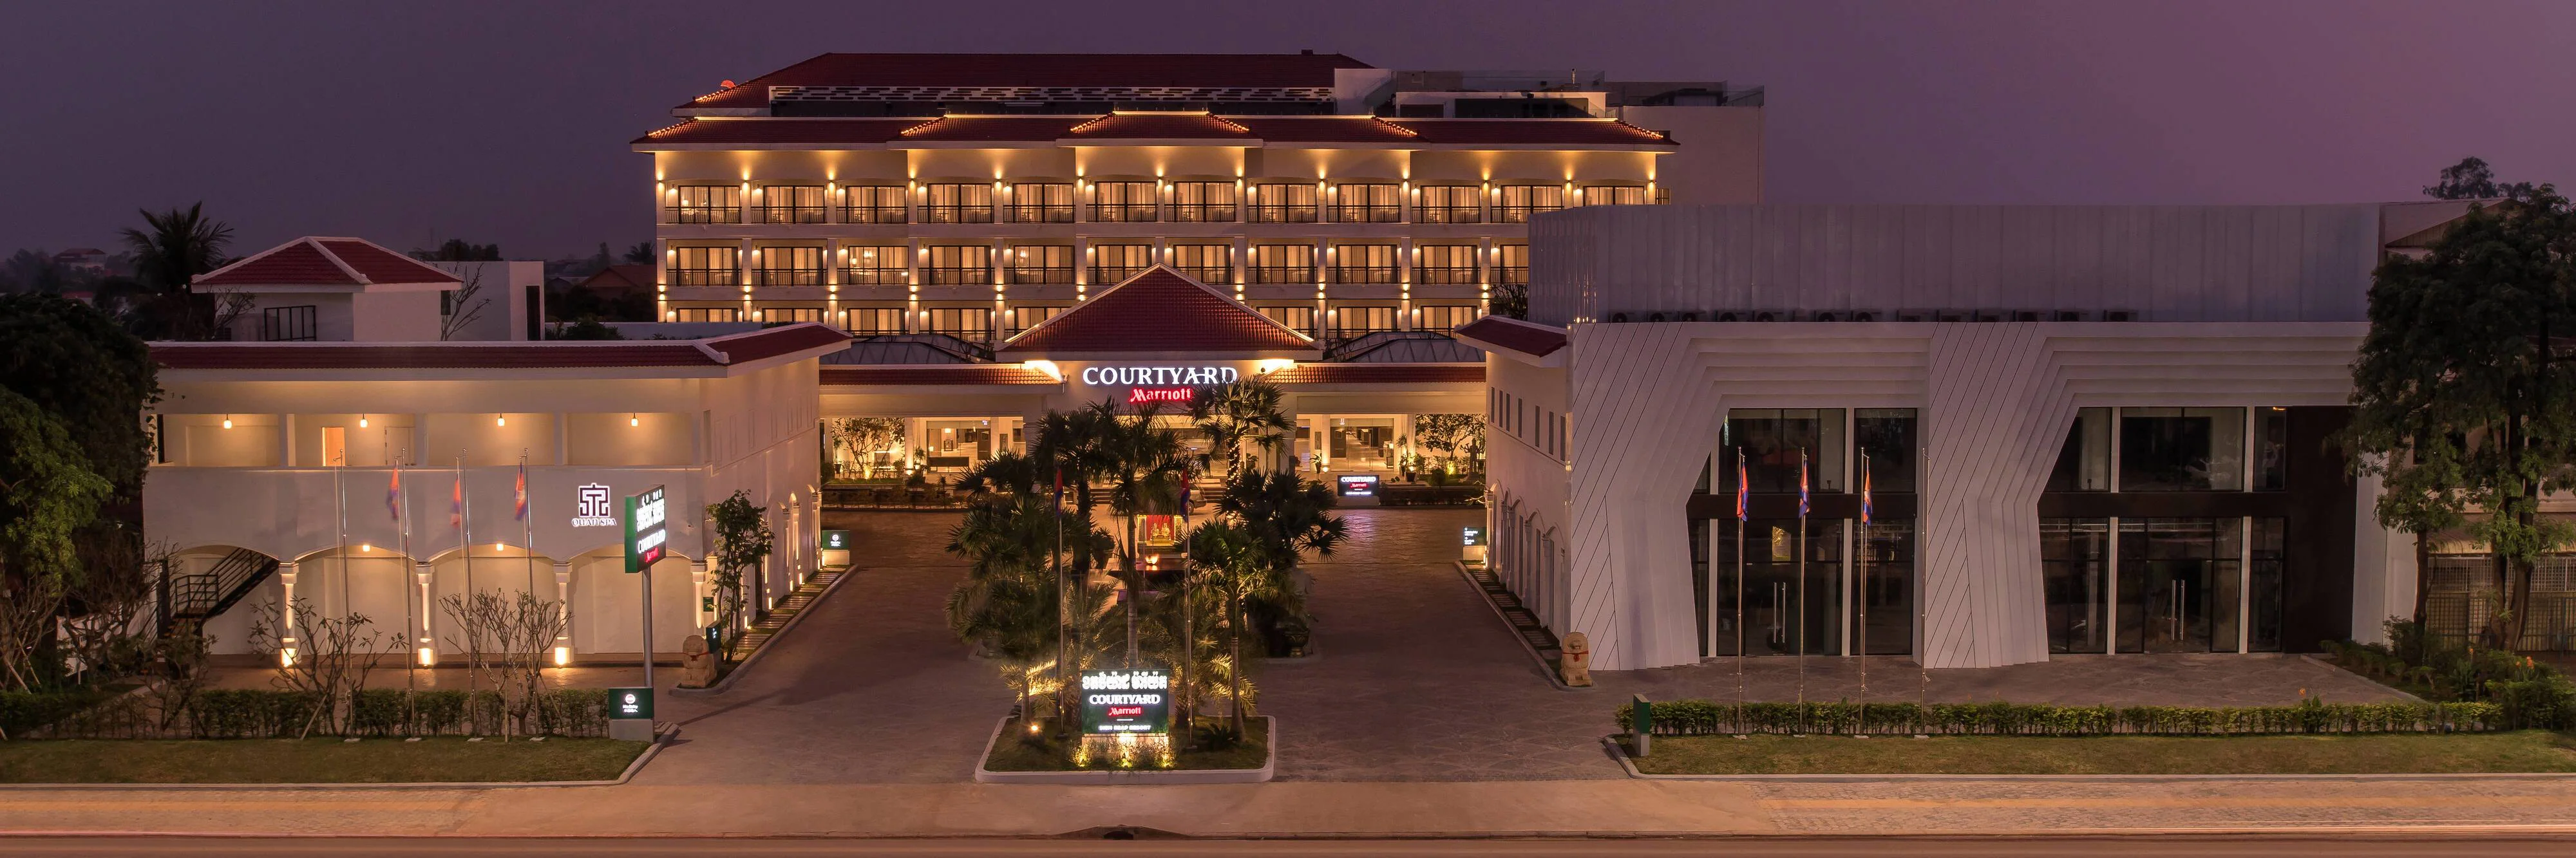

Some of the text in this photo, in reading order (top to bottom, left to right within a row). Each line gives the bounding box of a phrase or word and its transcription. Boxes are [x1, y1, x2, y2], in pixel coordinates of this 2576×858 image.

[1083, 367, 1238, 385] COURTYARD
[1129, 387, 1191, 402] Marriott
[572, 518, 617, 527] QUAN SPA
[1089, 695, 1161, 705] COURTYARD
[1109, 707, 1141, 716] Marriott
